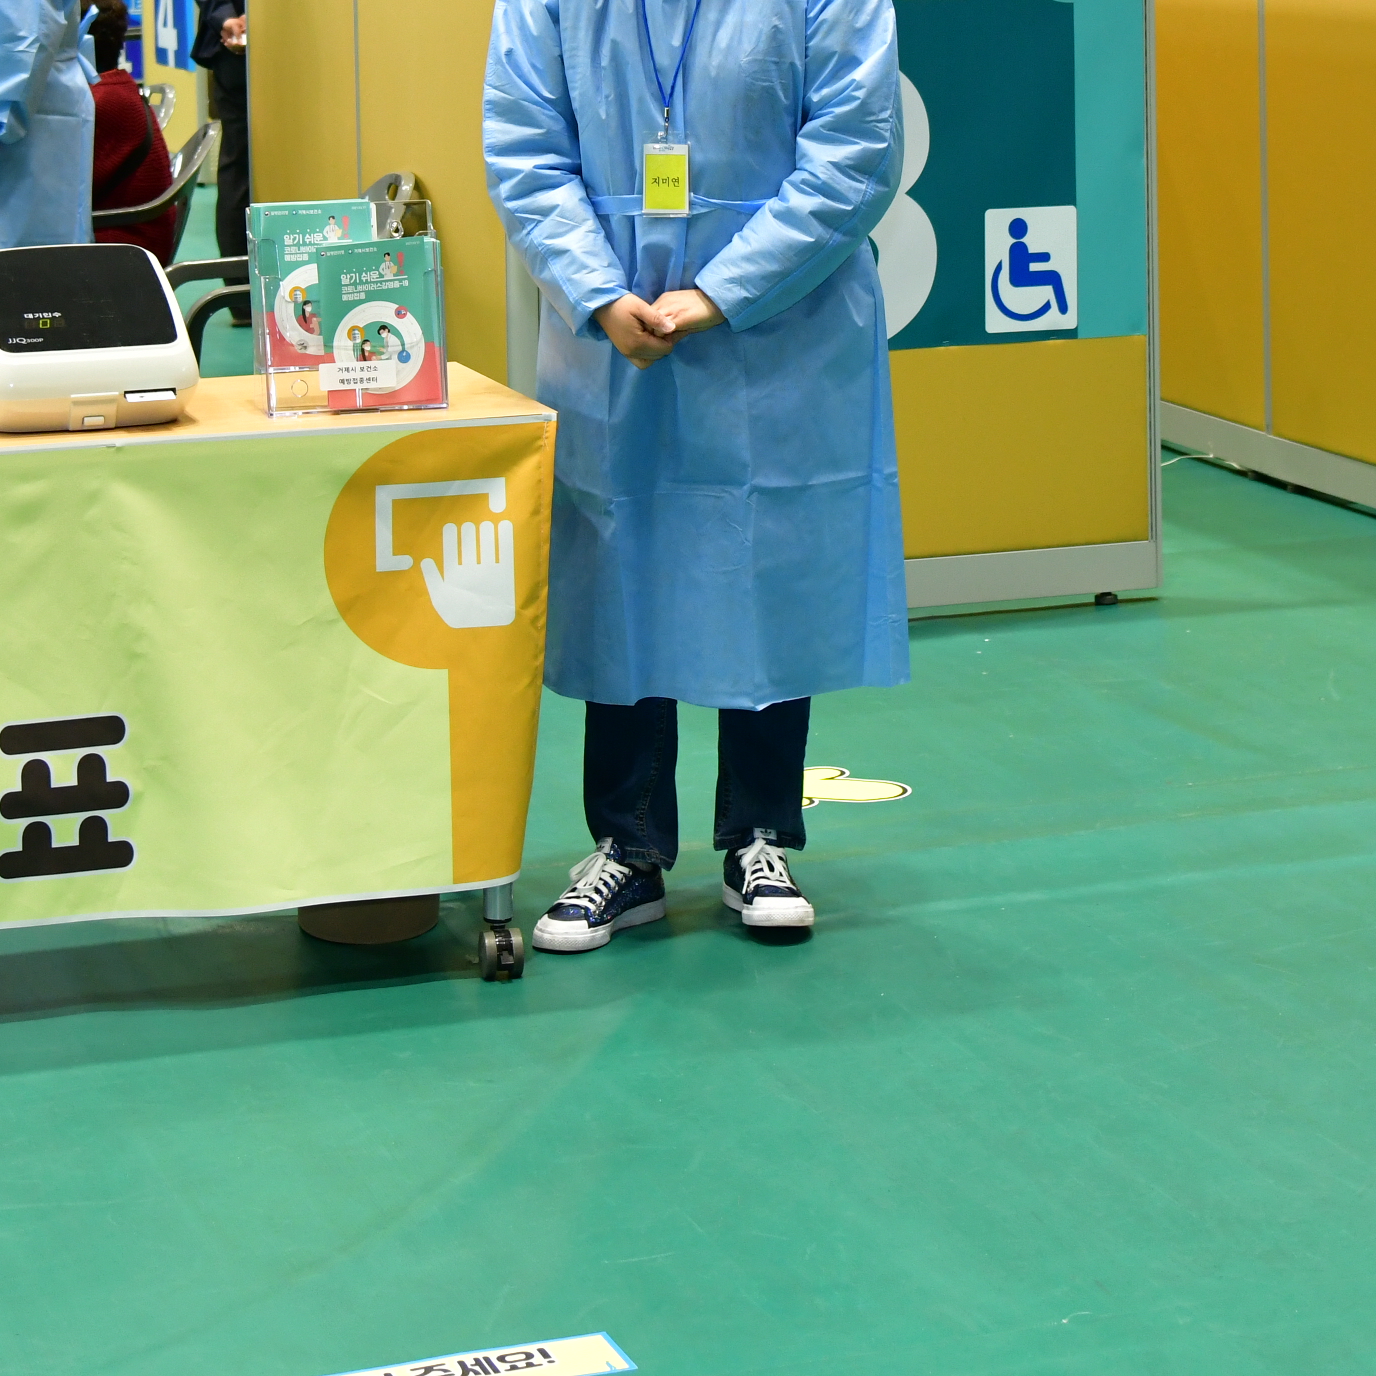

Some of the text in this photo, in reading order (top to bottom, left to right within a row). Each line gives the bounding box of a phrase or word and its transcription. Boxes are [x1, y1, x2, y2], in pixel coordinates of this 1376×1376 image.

[284, 233, 323, 245] 알기 쉬운
[341, 270, 380, 285] 알기 쉬운
[359, 365, 379, 373] 보건소
[339, 376, 378, 385] 예방접종센터
